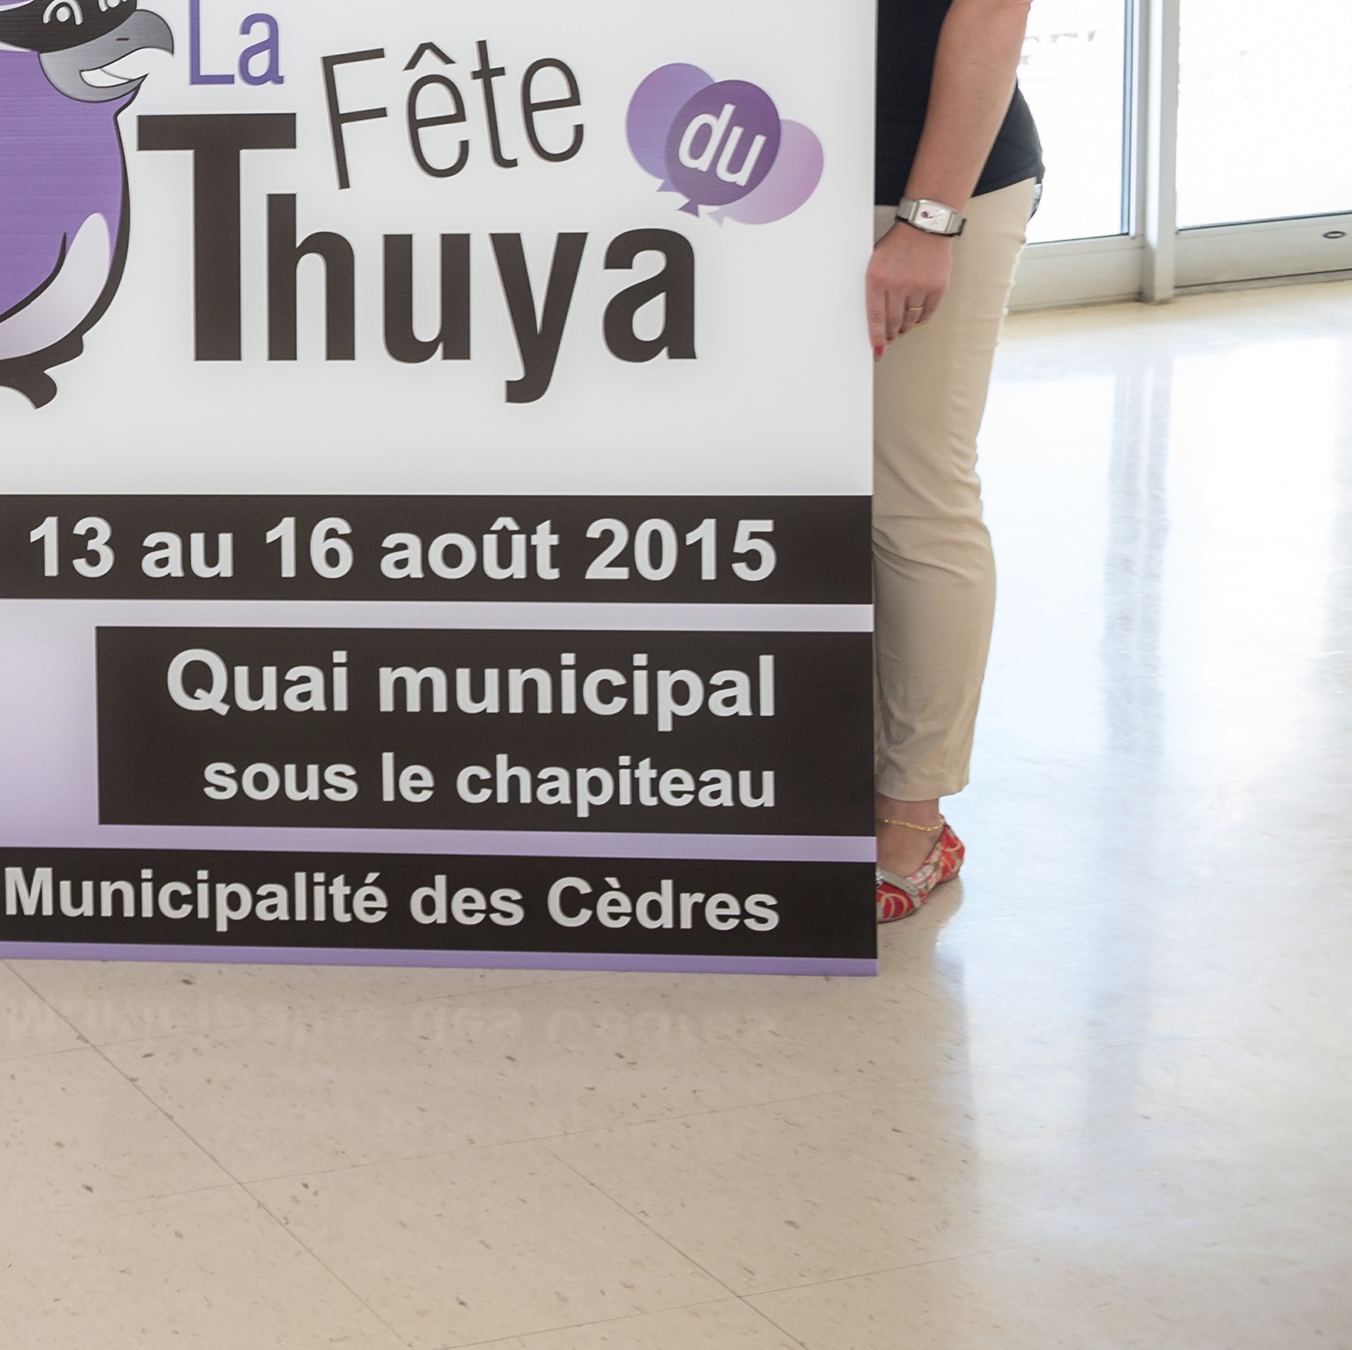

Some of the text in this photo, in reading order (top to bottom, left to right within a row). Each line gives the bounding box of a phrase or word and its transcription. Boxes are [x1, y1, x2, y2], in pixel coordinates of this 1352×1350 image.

[320, 38, 587, 191] Fête
[676, 101, 769, 189] du
[135, 111, 700, 406] Thuya
[28, 515, 778, 583] 13 au 16 août 2015
[166, 647, 776, 733] Quai municipal
[202, 750, 776, 819] sous le chapiteau
[3, 865, 780, 933] Municipalité des Cèdres
